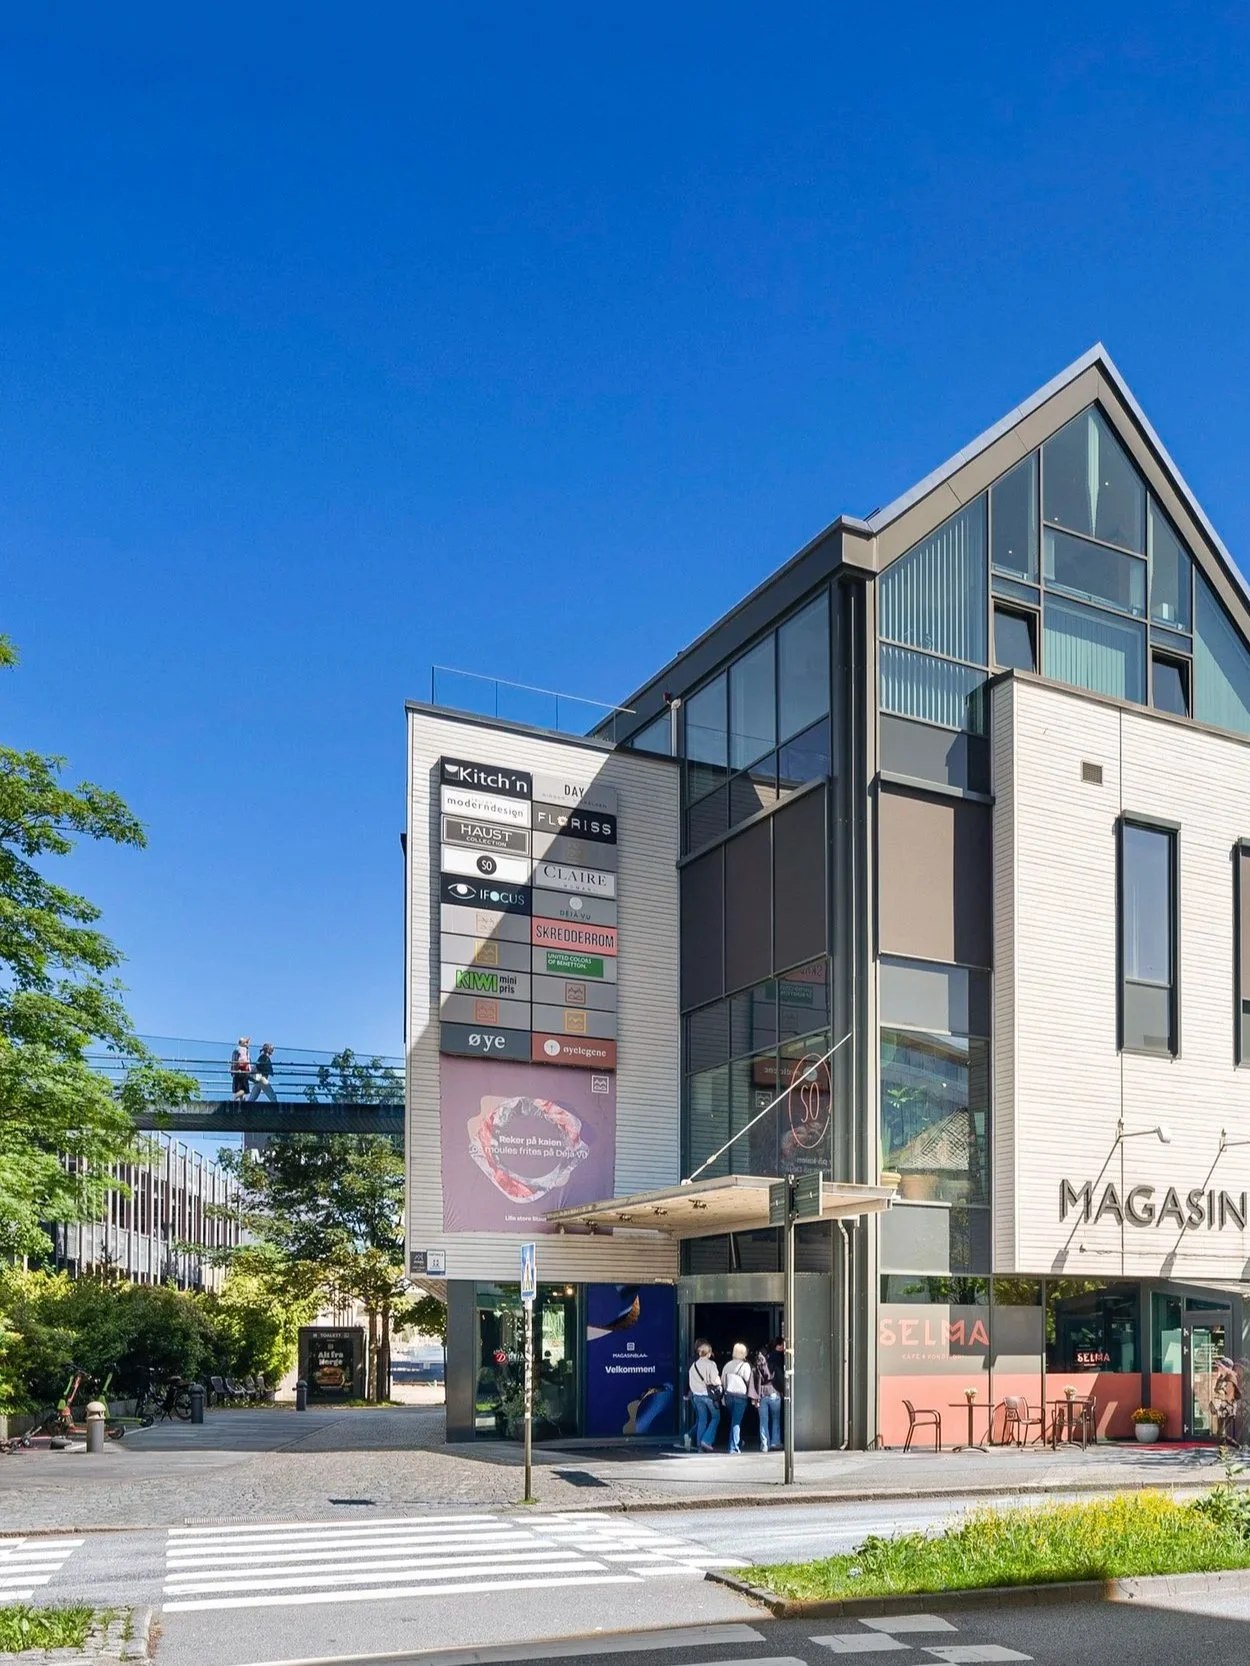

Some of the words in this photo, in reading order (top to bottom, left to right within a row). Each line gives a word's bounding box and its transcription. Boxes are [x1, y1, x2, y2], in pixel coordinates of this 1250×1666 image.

[564, 784, 585, 798] DAY
[460, 823, 513, 842] HAUST
[466, 836, 507, 848] COLLECTION
[481, 860, 493, 872] SO
[543, 864, 607, 887] CLAIRE
[535, 925, 615, 949] SKREDDERROM
[547, 953, 569, 961] UNITED
[569, 956, 592, 965] COLORS
[455, 969, 498, 993] KIWI
[499, 975, 517, 985] mini
[499, 985, 516, 994] pris
[468, 1033, 506, 1052] øye
[800, 1082, 820, 1123] SO
[499, 1135, 525, 1145] Reker
[525, 1136, 537, 1146] på
[538, 1137, 562, 1147] kaien
[485, 1146, 518, 1155] moules
[519, 1146, 542, 1156] frites
[879, 1317, 990, 1346] SELMA
[1076, 1352, 1111, 1363] SELMA
[604, 1365, 656, 1374] Velkommen!
